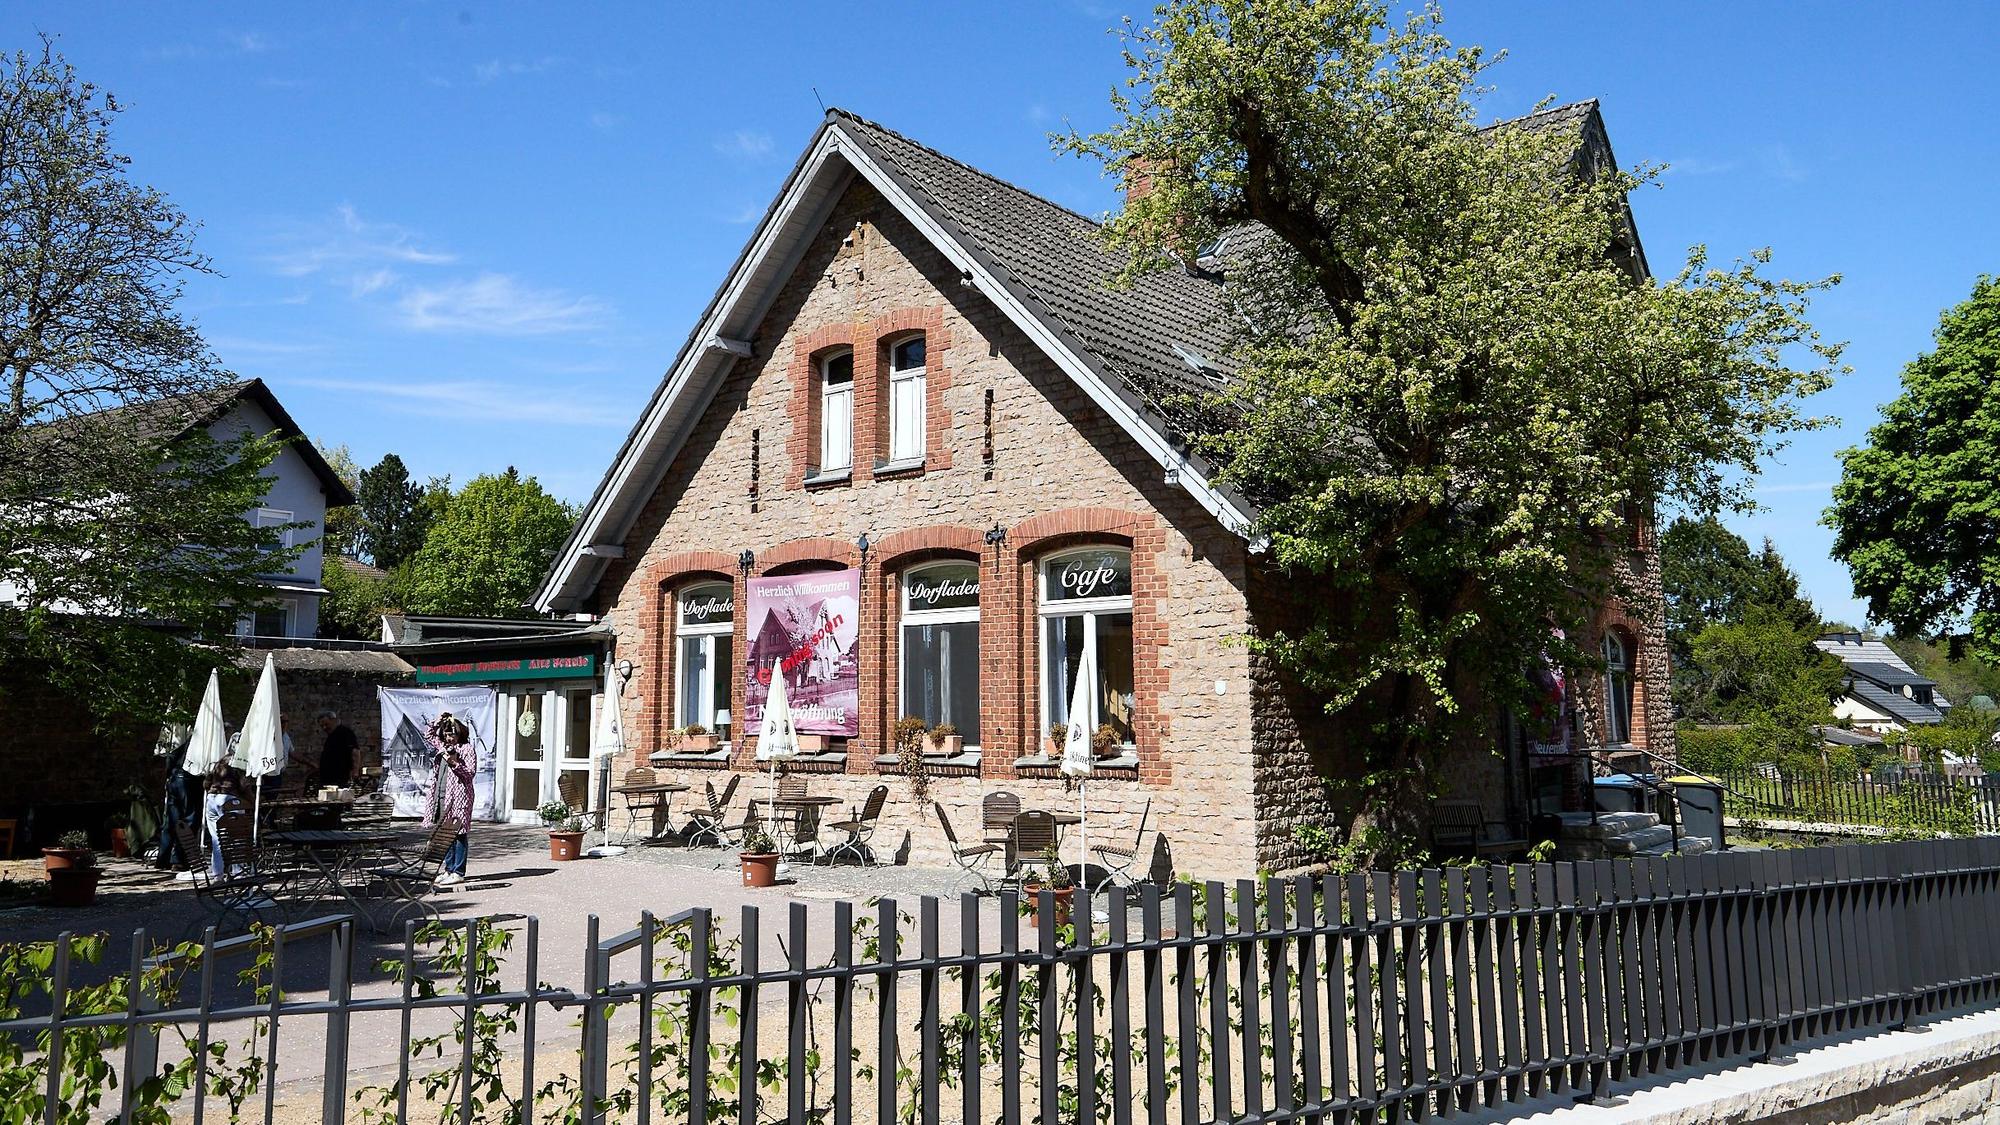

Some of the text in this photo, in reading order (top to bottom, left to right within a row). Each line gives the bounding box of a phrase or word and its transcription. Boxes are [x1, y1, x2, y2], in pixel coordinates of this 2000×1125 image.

[757, 581, 850, 597] Herzlich Willkommen
[1061, 556, 1118, 596] Café
[909, 578, 980, 604] Dorfladen
[812, 614, 844, 646] soon
